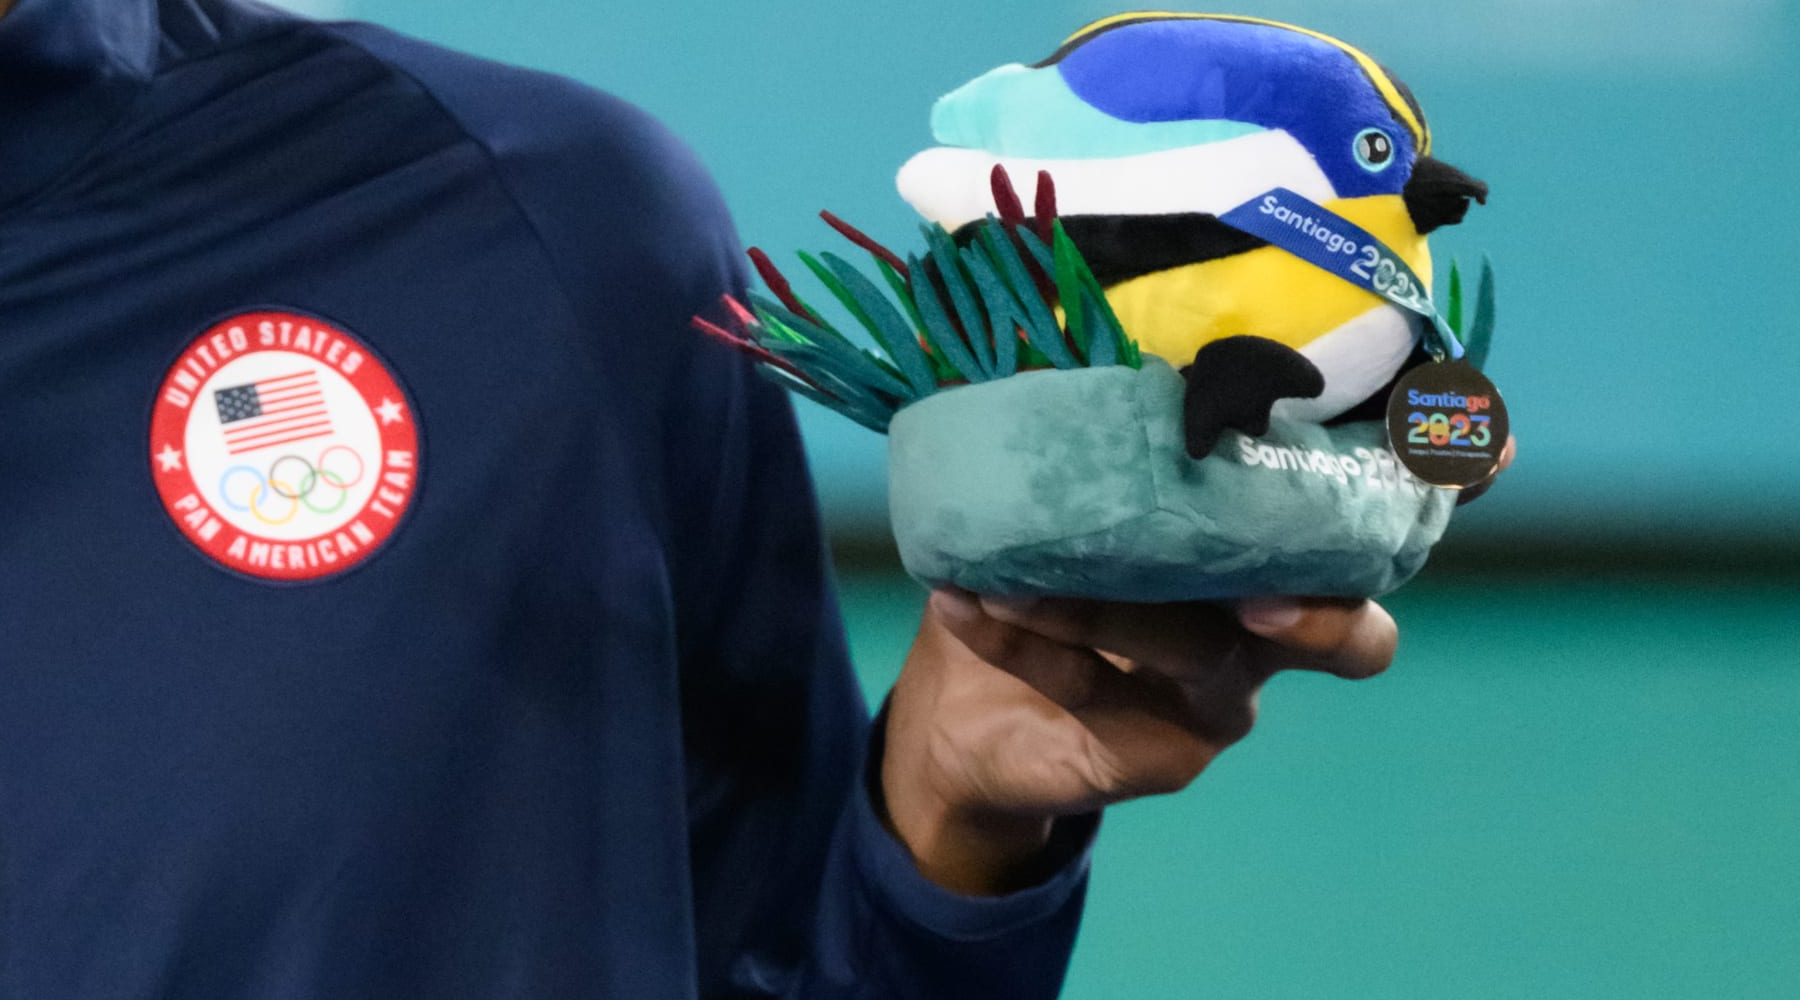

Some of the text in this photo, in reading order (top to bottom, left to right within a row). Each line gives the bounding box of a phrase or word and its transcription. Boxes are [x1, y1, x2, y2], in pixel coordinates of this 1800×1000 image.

[1259, 195, 1357, 255] Santiago
[164, 321, 364, 408] UNITED STATES
[1407, 389, 1490, 413] Santiago
[1407, 411, 1491, 447] 2023
[1237, 434, 1362, 485] Santiago
[174, 449, 413, 569] PAN AMERICAN TEAM
